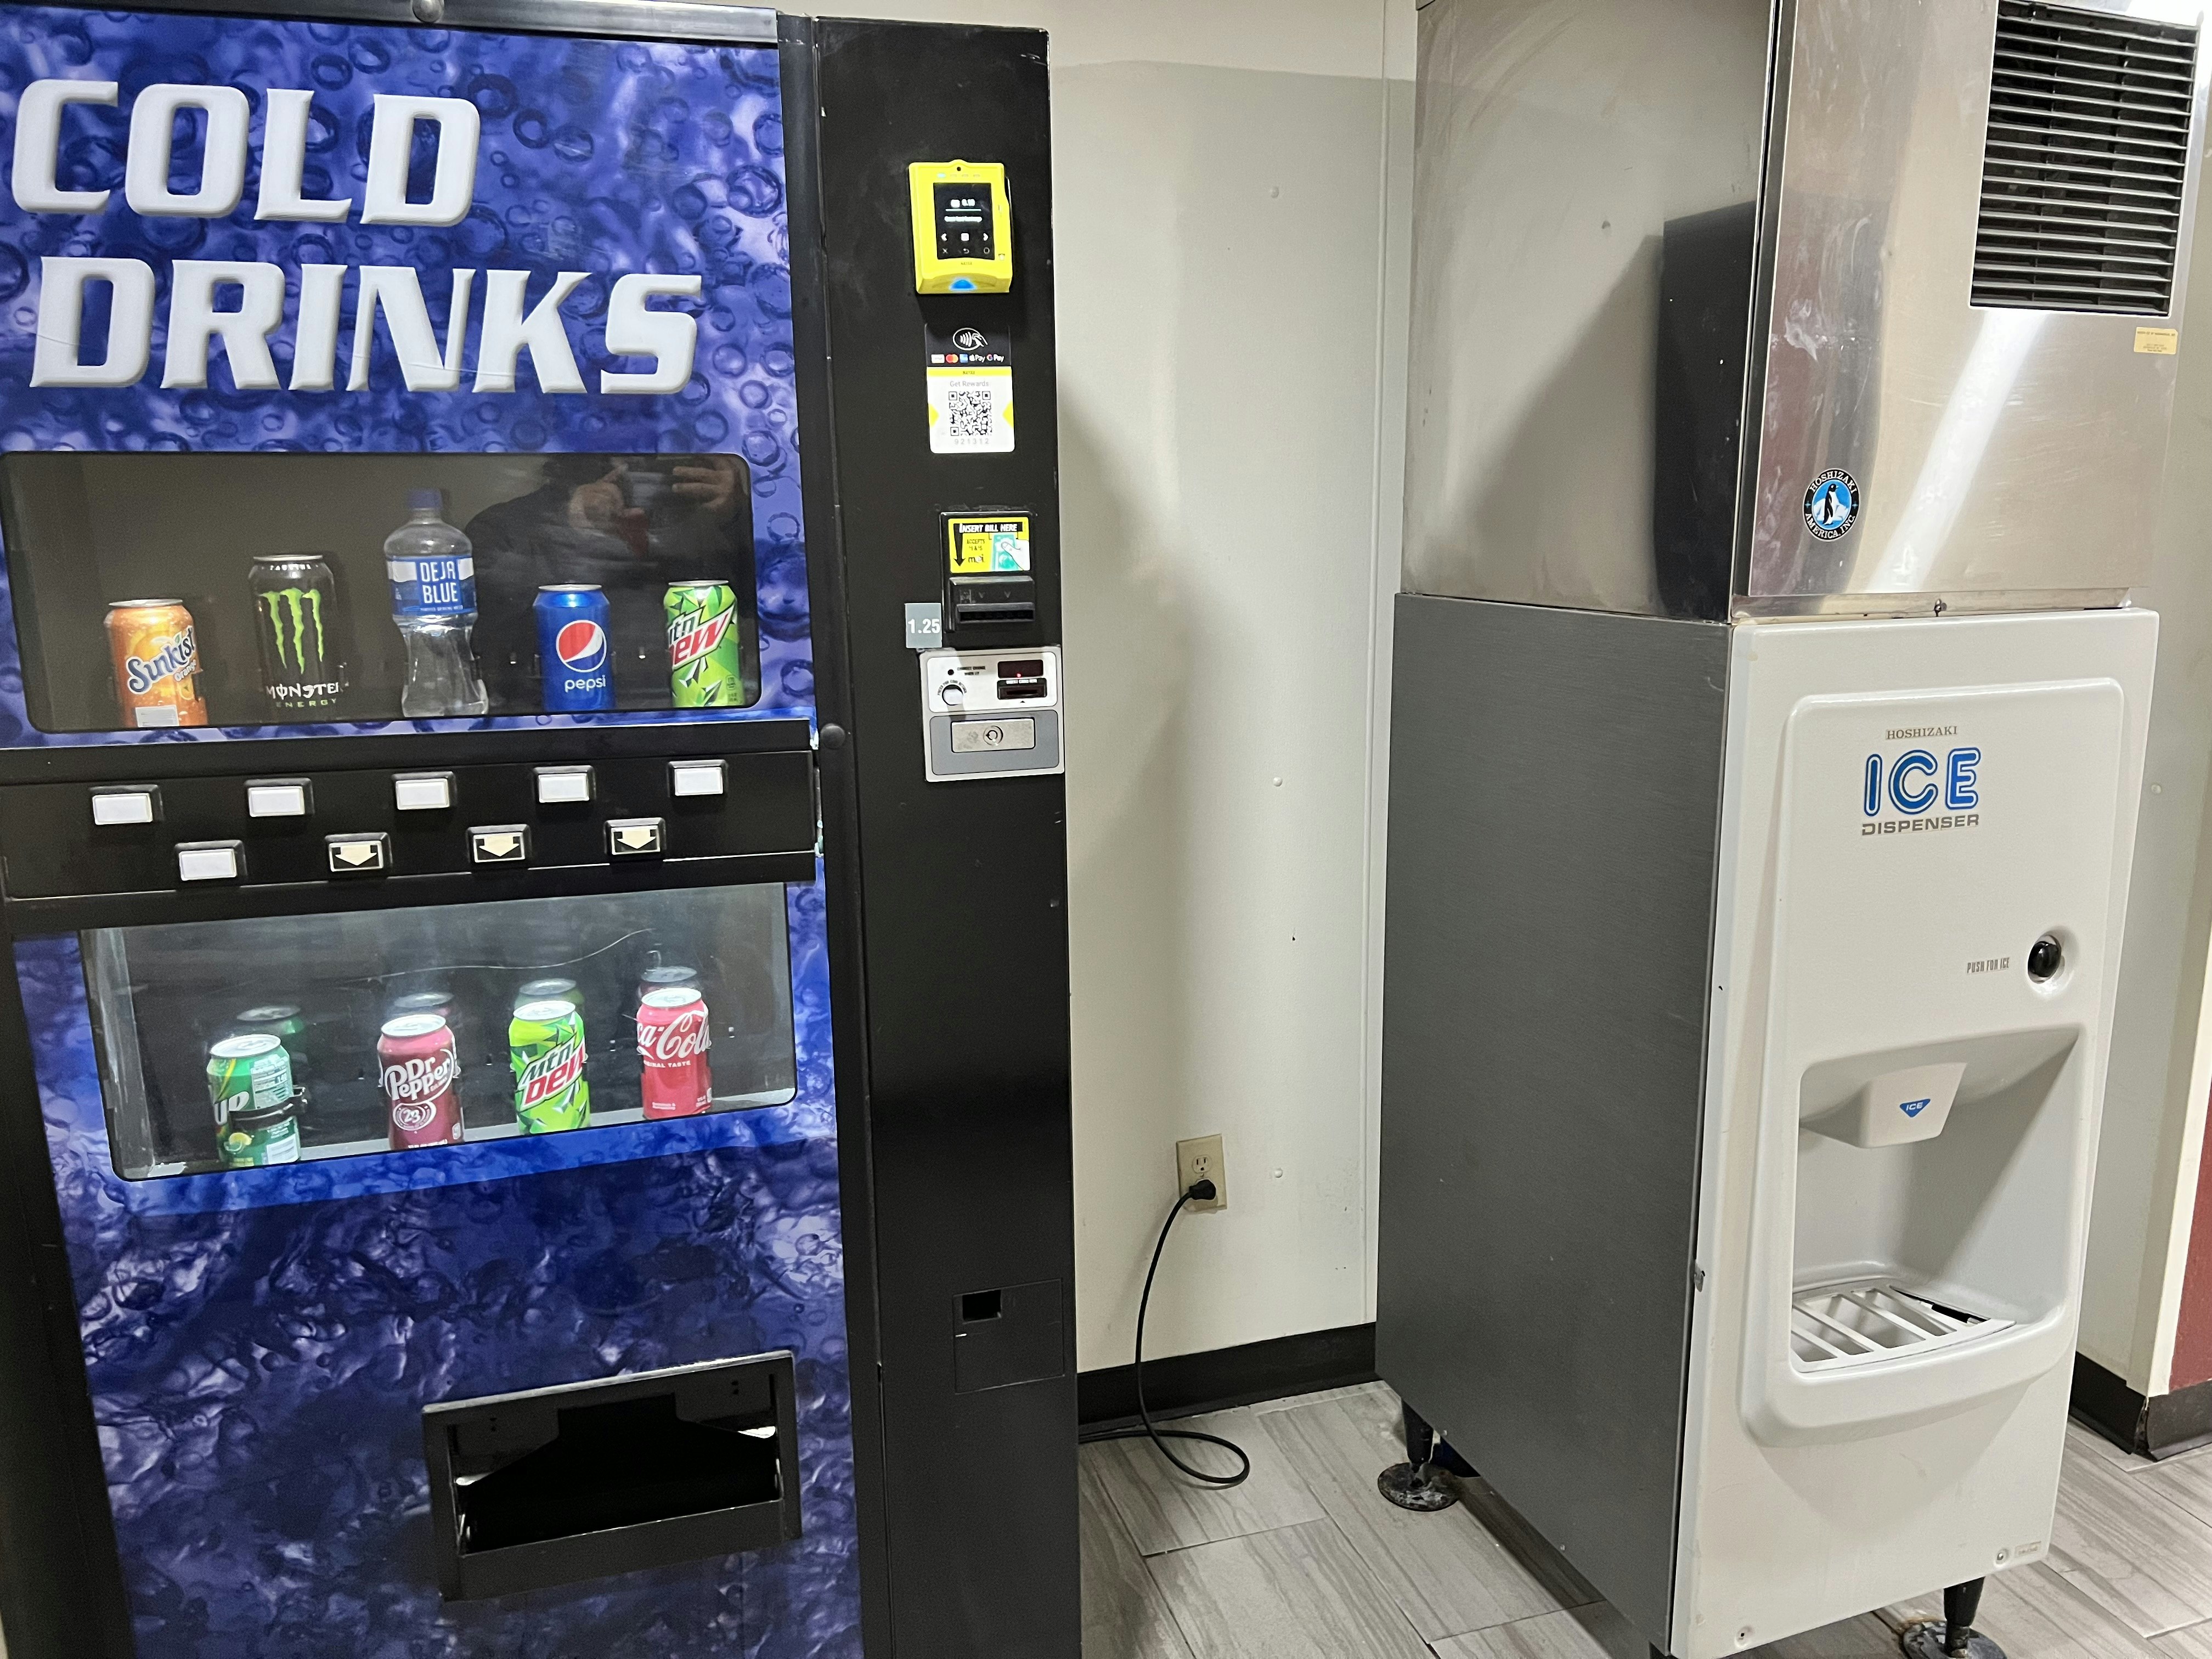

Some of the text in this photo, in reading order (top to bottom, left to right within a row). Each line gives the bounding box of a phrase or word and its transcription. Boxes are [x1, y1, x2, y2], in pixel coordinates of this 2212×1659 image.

[11, 79, 481, 227] COLD
[29, 256, 702, 394] DRINKS
[1809, 471, 1857, 494] HOSHIZAKI
[959, 523, 1018, 533] INSERT BILL HERE
[420, 561, 456, 582] DEJA
[422, 582, 458, 604] BLUE
[907, 618, 941, 634] 1.25
[565, 675, 606, 692] pepsi
[275, 697, 337, 708] ENERGY
[1887, 726, 1958, 740] HOSHIZAKI
[1864, 747, 1982, 817] ICE
[1861, 814, 1979, 836] DISPENSER
[1967, 957, 2010, 974] PUSH FOR ICE
[384, 1058, 450, 1101] Pepper
[405, 1057, 436, 1082] Dr
[1905, 1102, 1923, 1111] ICE
